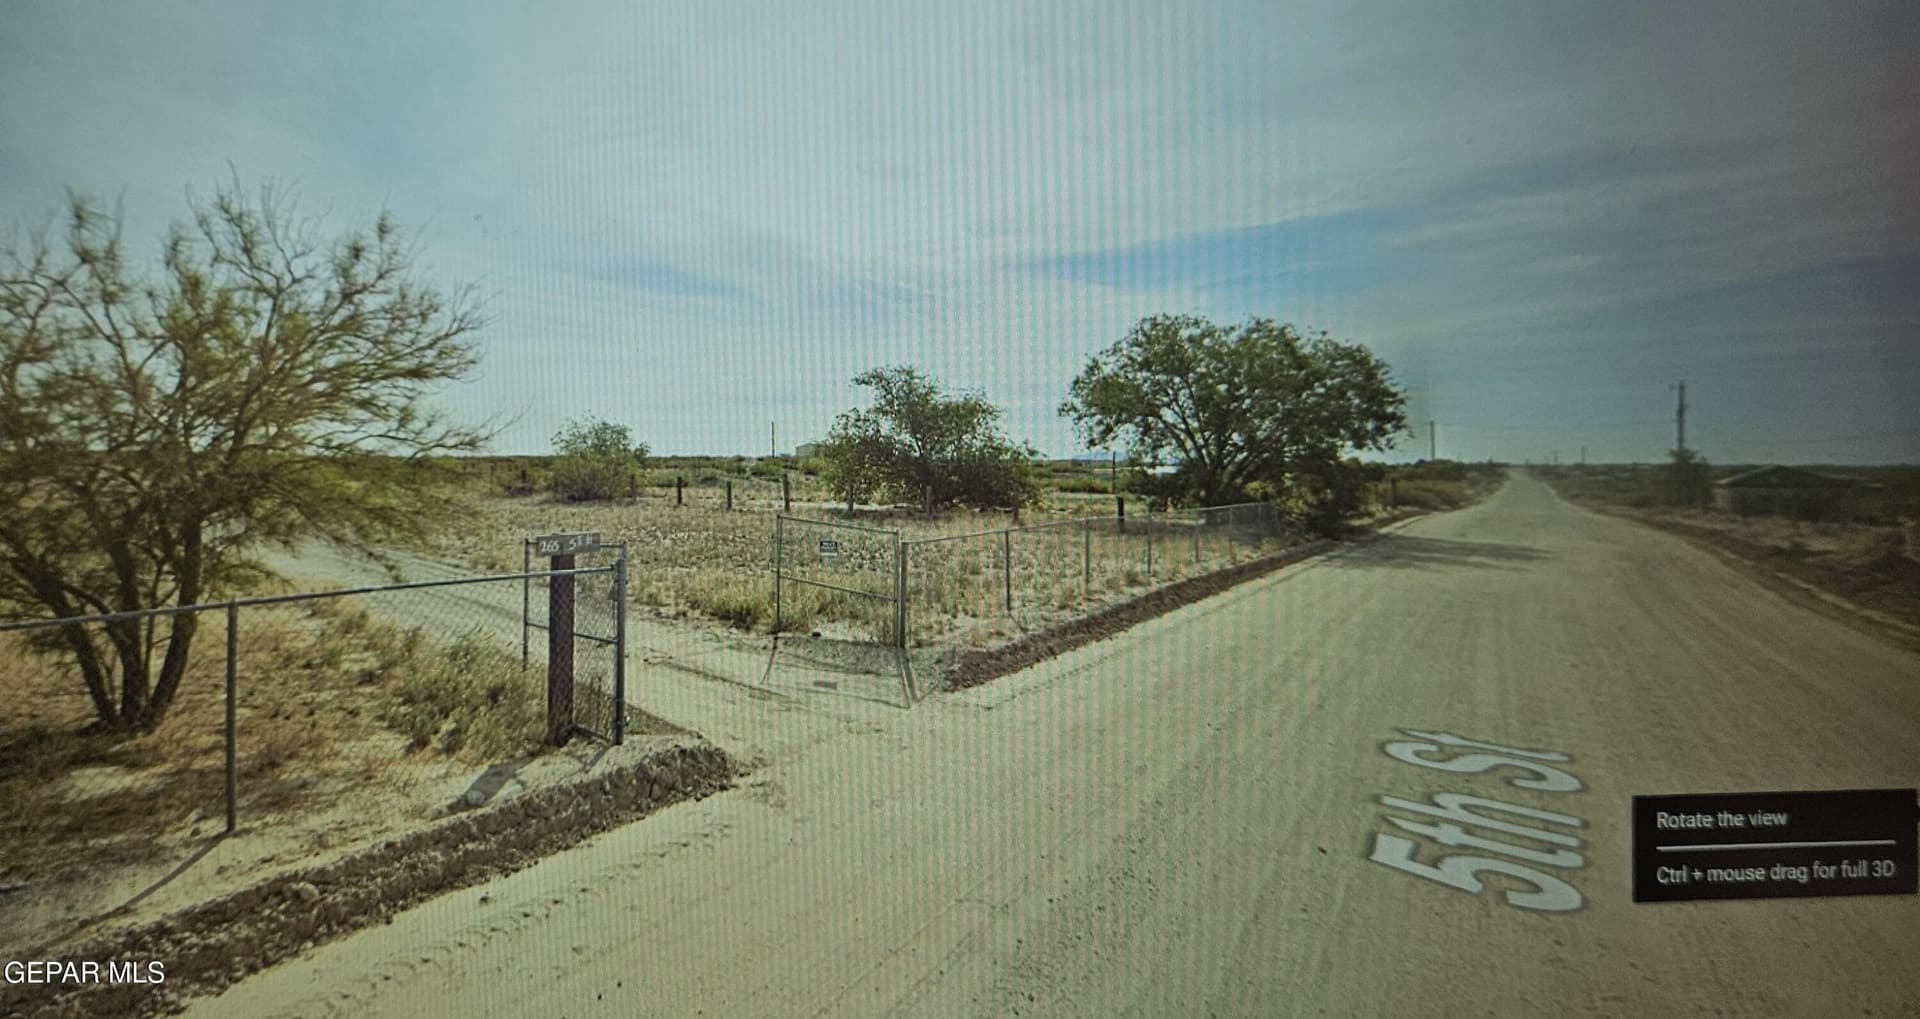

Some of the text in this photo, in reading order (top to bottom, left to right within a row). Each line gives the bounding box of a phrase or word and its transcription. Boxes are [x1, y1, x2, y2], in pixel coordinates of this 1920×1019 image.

[1368, 727, 1584, 911] 5th St
[1656, 809, 1788, 829] Rotate the view
[1656, 864, 1688, 884] Ctrl
[1707, 867, 1766, 883] mouse
[1770, 863, 1809, 883] drag
[1812, 860, 1836, 879] for
[1841, 859, 1868, 877] full
[1872, 859, 1895, 877] 3D
